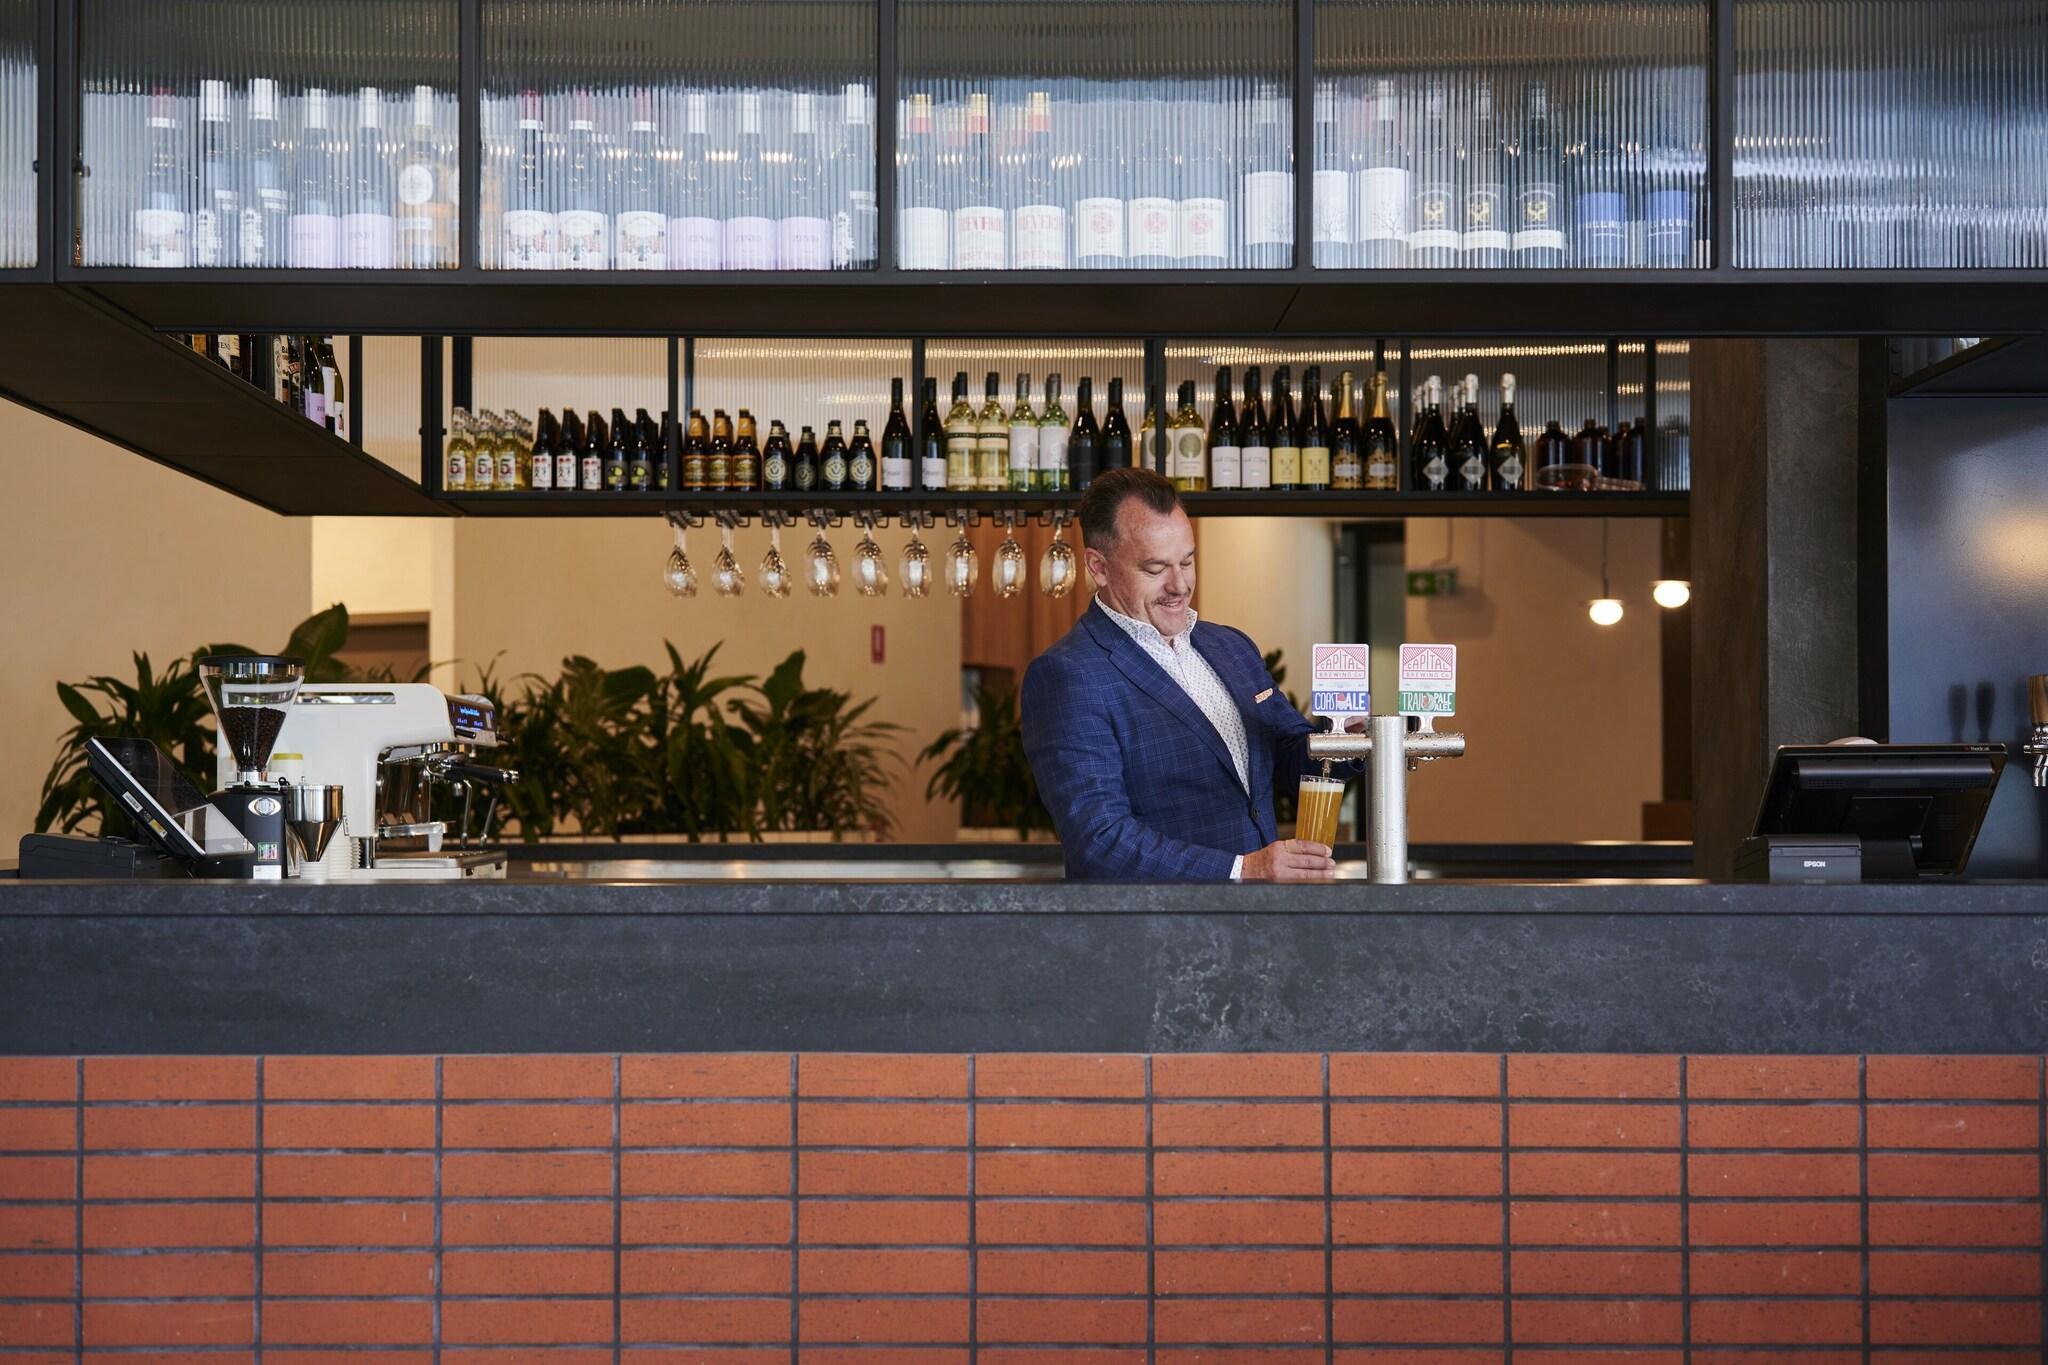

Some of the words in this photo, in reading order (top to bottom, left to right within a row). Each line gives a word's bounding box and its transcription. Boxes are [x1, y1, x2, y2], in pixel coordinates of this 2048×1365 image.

[1320, 650, 1361, 669] CAPITAL
[1408, 650, 1449, 669] CAPITAL
[1315, 692, 1338, 711] COAST
[1345, 692, 1366, 711] ALE
[1804, 860, 1826, 868] EPSON
